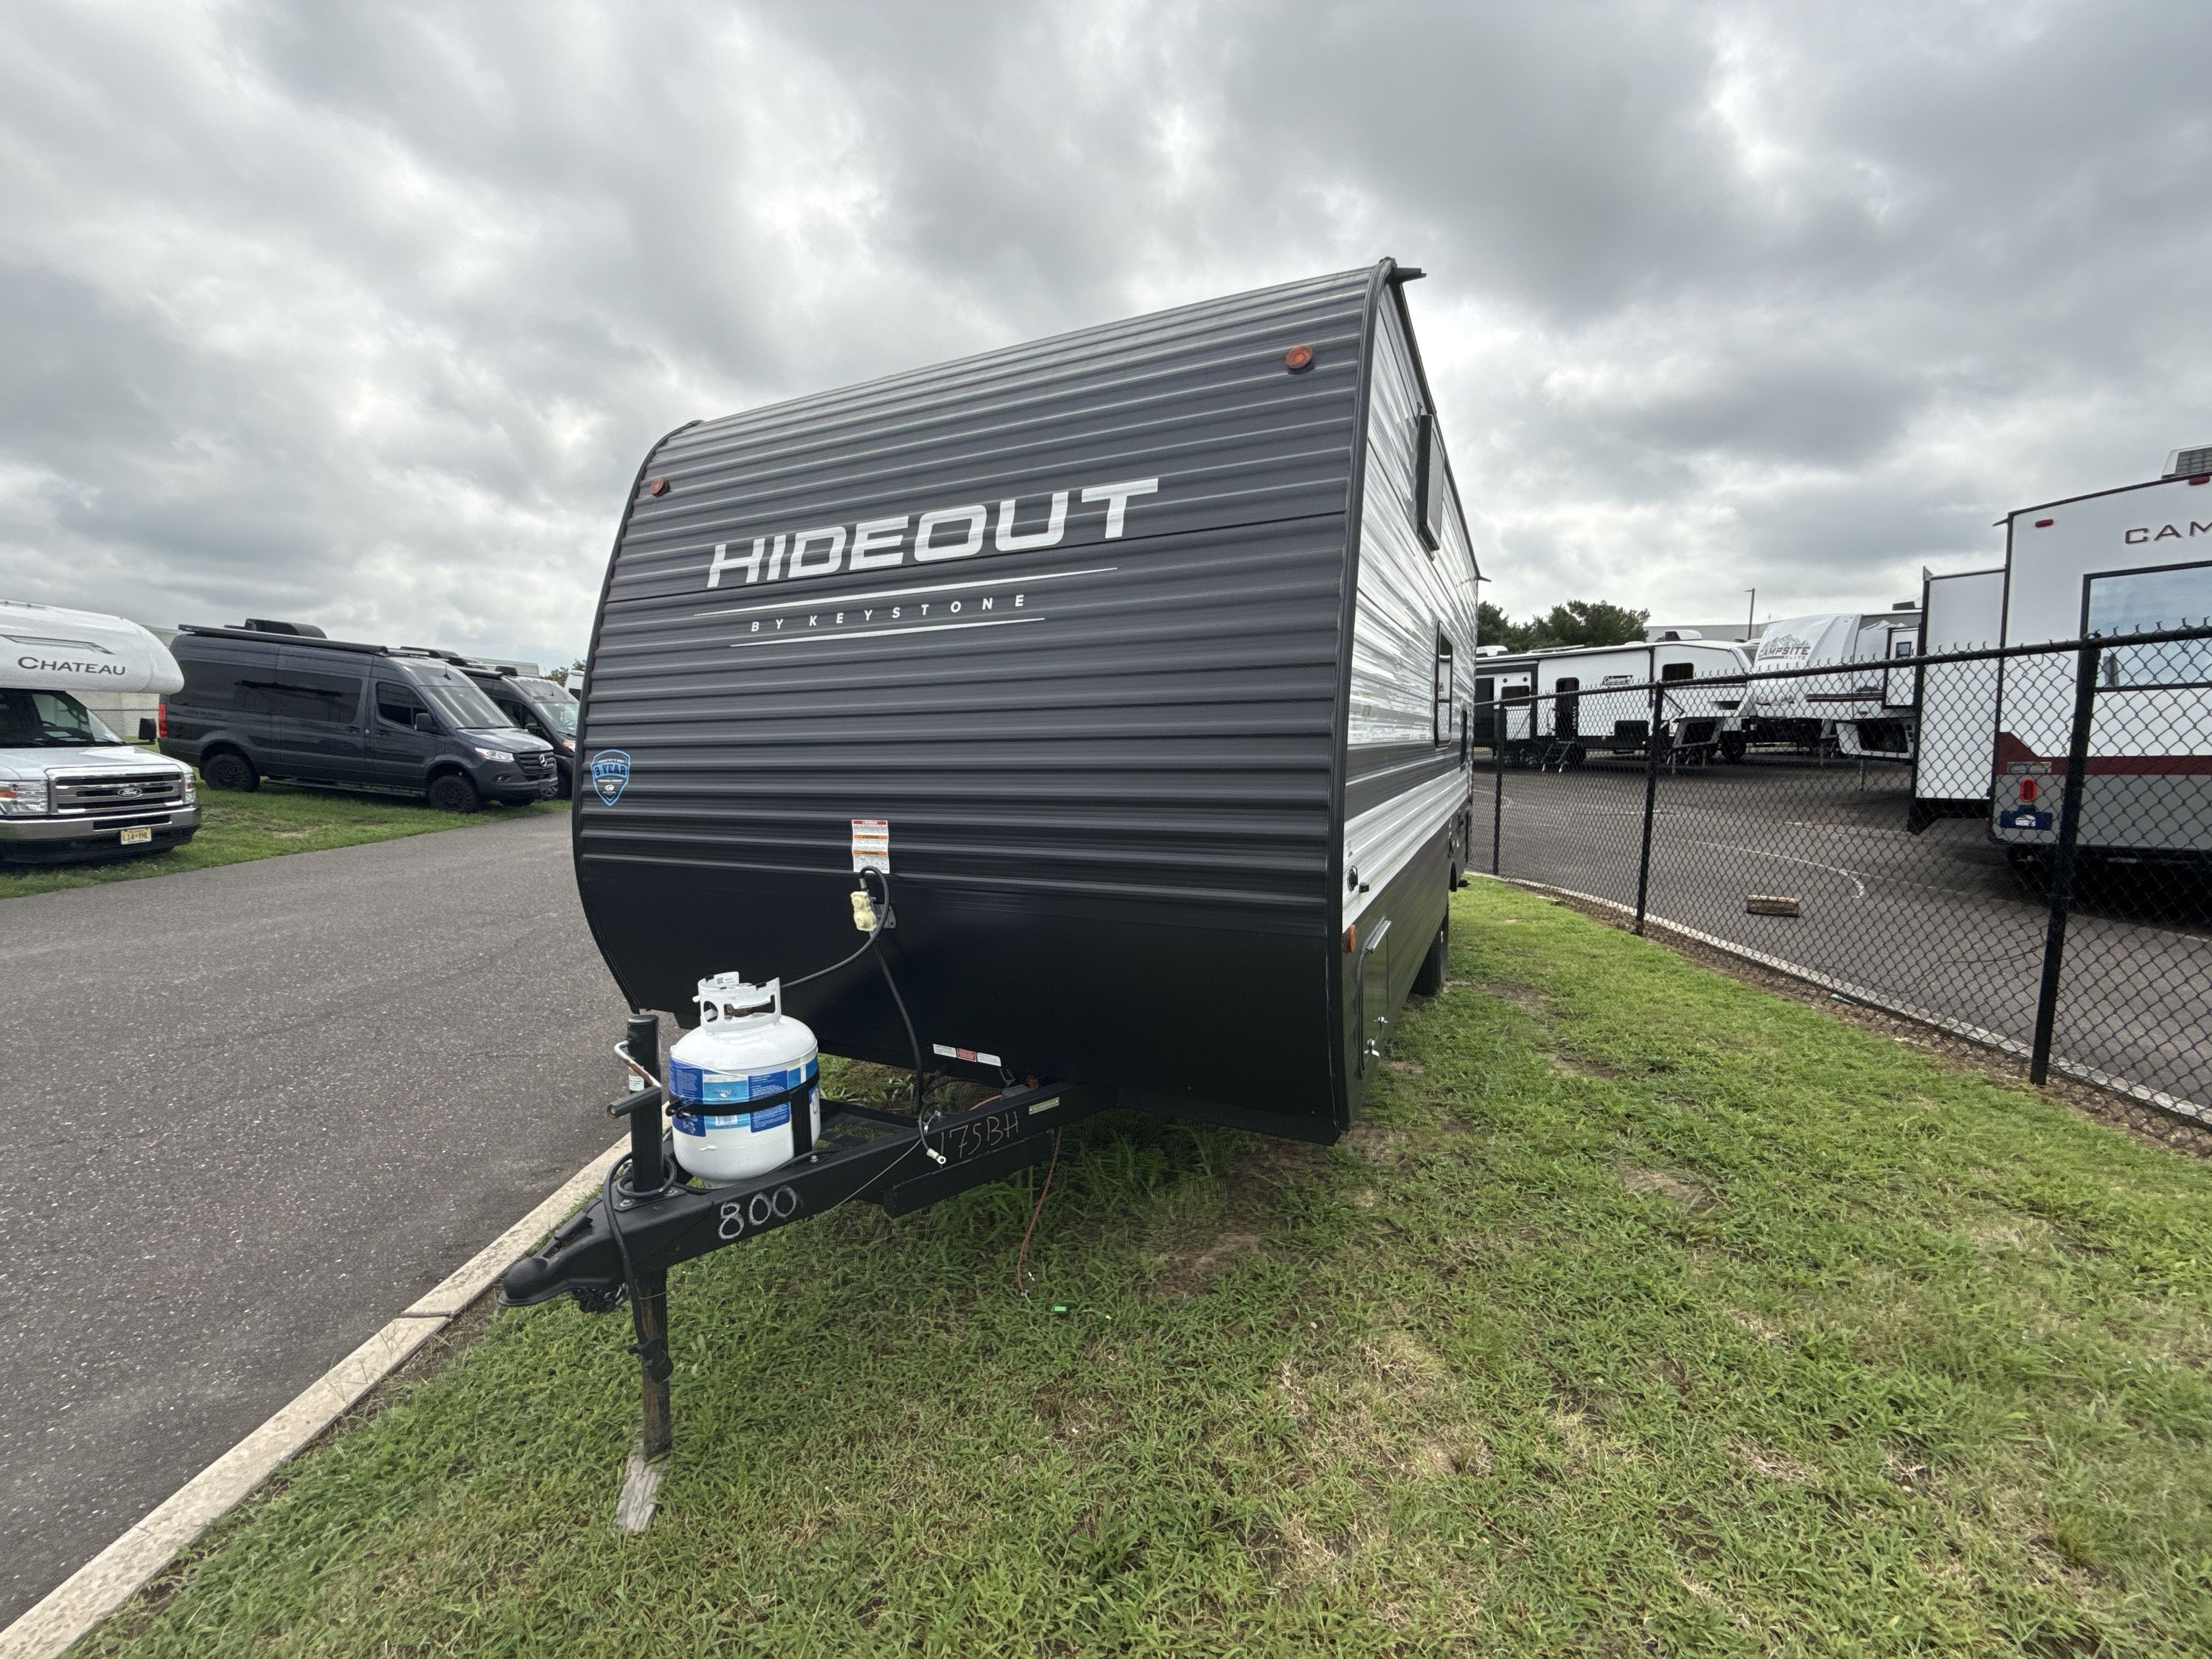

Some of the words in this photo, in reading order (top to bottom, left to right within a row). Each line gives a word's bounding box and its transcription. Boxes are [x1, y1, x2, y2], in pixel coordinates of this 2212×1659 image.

[707, 478, 1158, 588] HIDEOUT
[751, 618, 783, 632] BY
[809, 594, 1025, 627] KEYSTONE
[1759, 647, 1811, 657] CAMPSITE
[595, 766, 601, 776] 3
[602, 764, 626, 776] YEAR
[718, 1184, 797, 1239] 800
